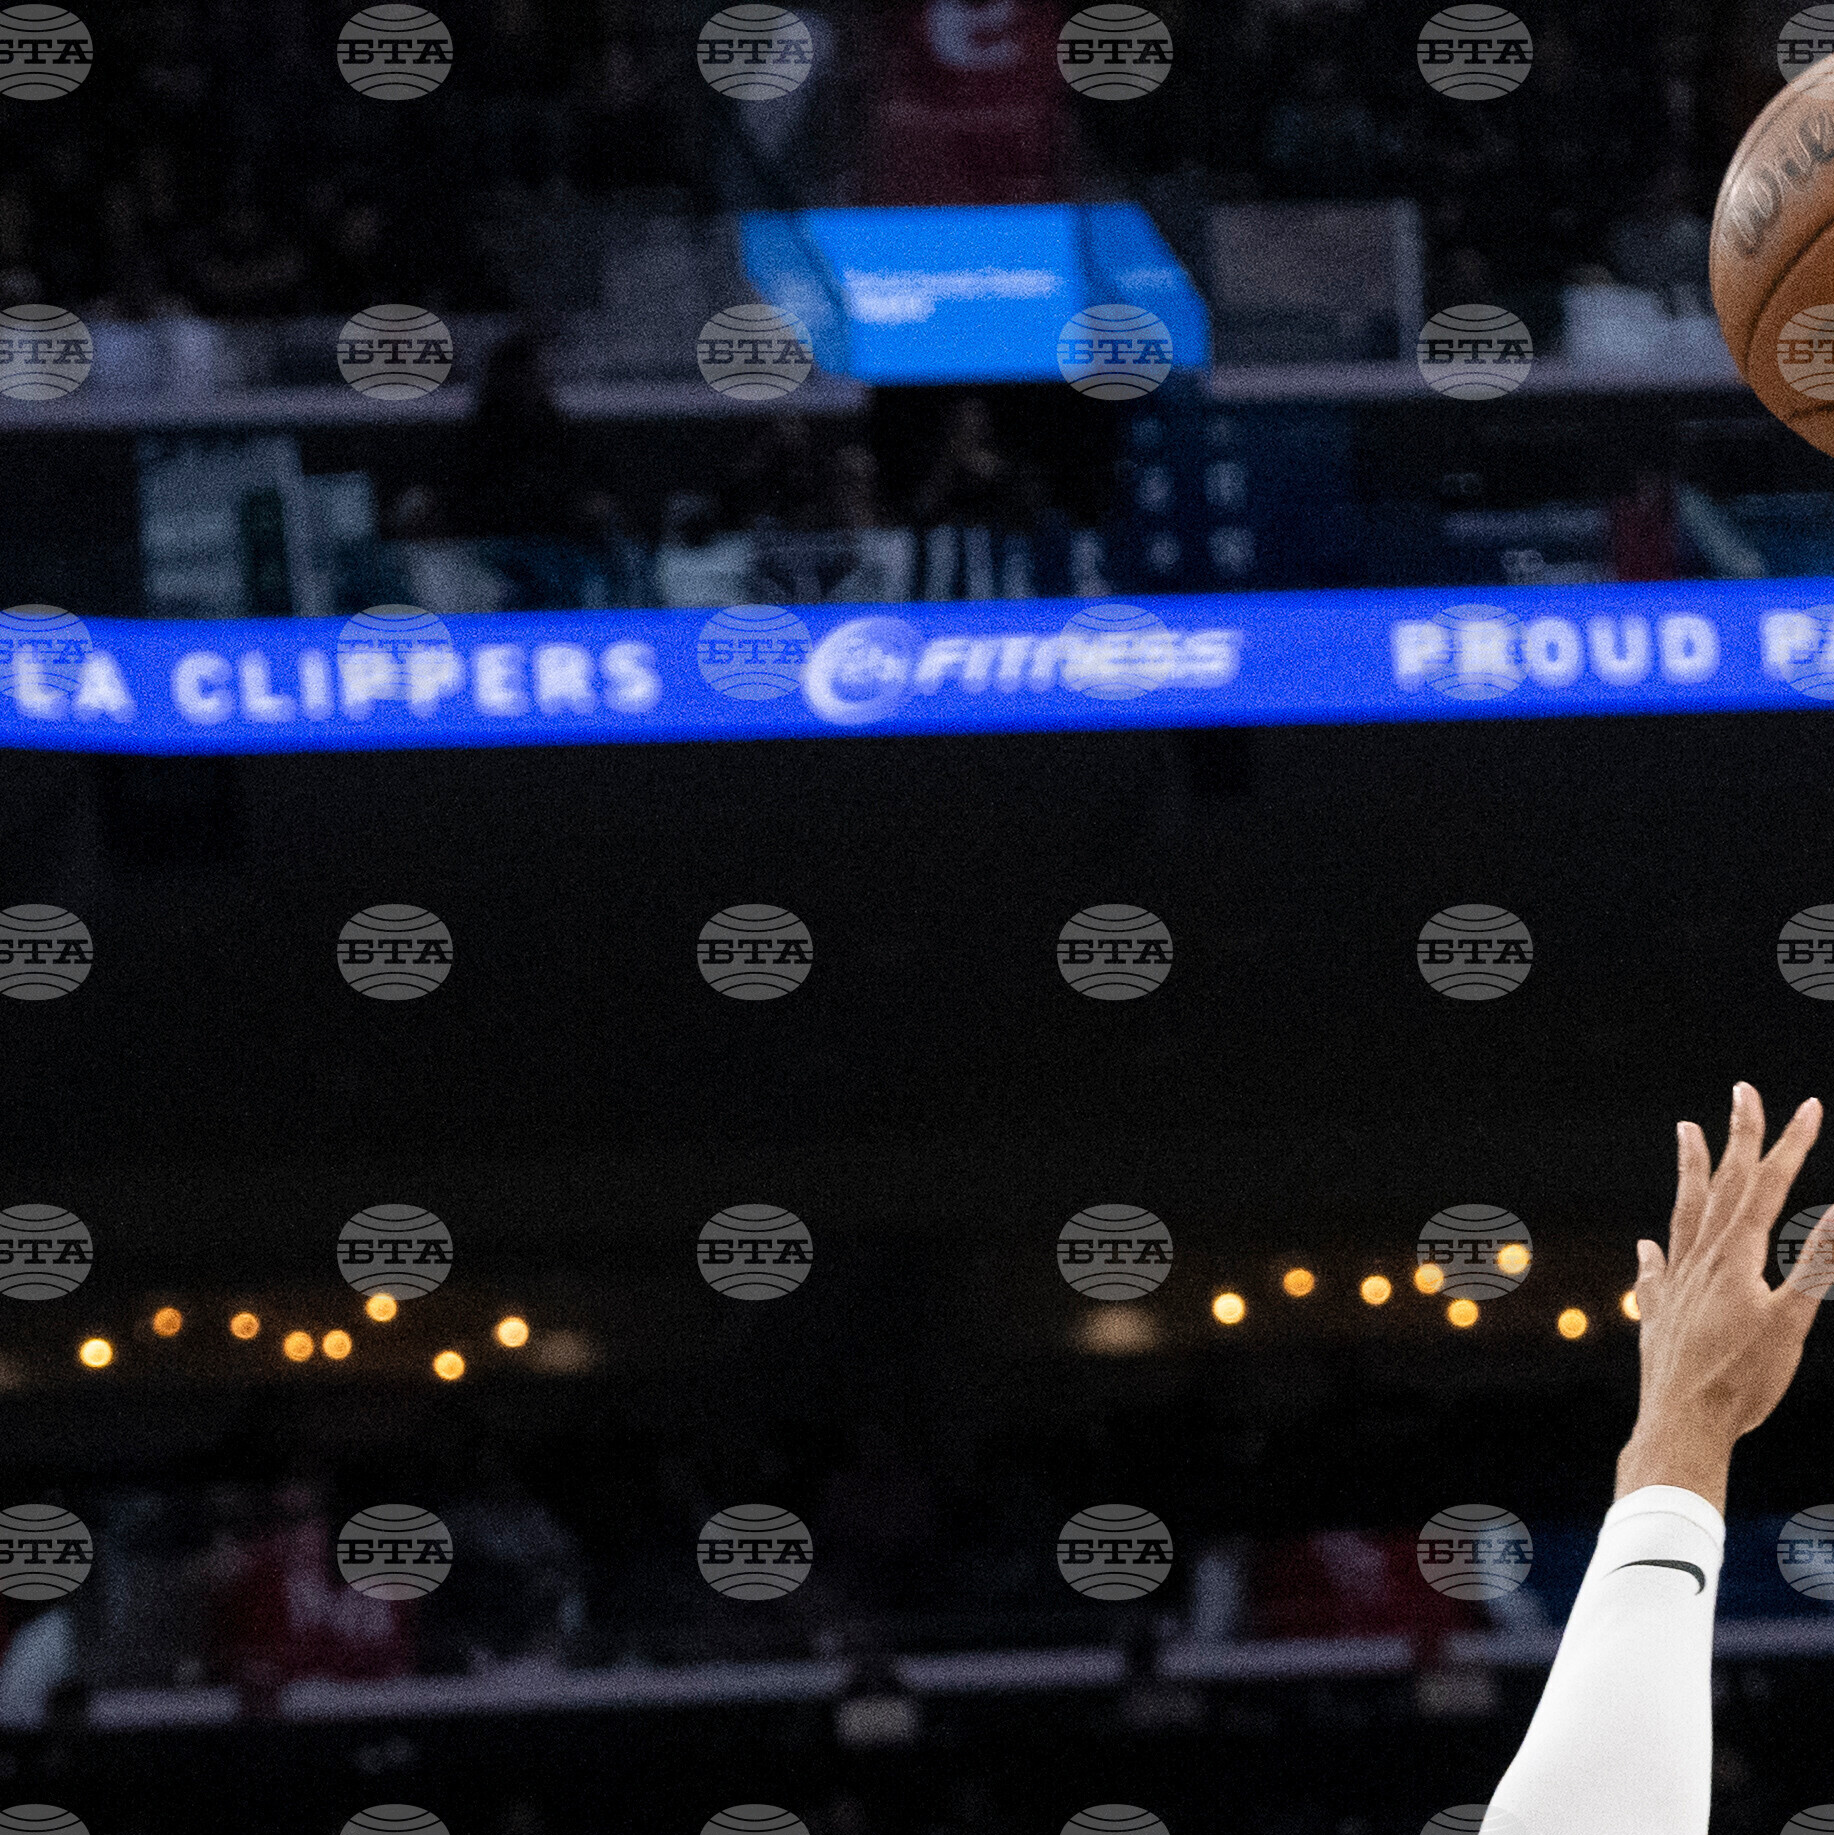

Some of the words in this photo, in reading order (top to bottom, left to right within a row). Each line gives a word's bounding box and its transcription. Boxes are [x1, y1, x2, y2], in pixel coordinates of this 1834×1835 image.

[14, 648, 137, 723] LA
[170, 641, 667, 726] CLIPPERS
[1390, 611, 1722, 692] PROUD
